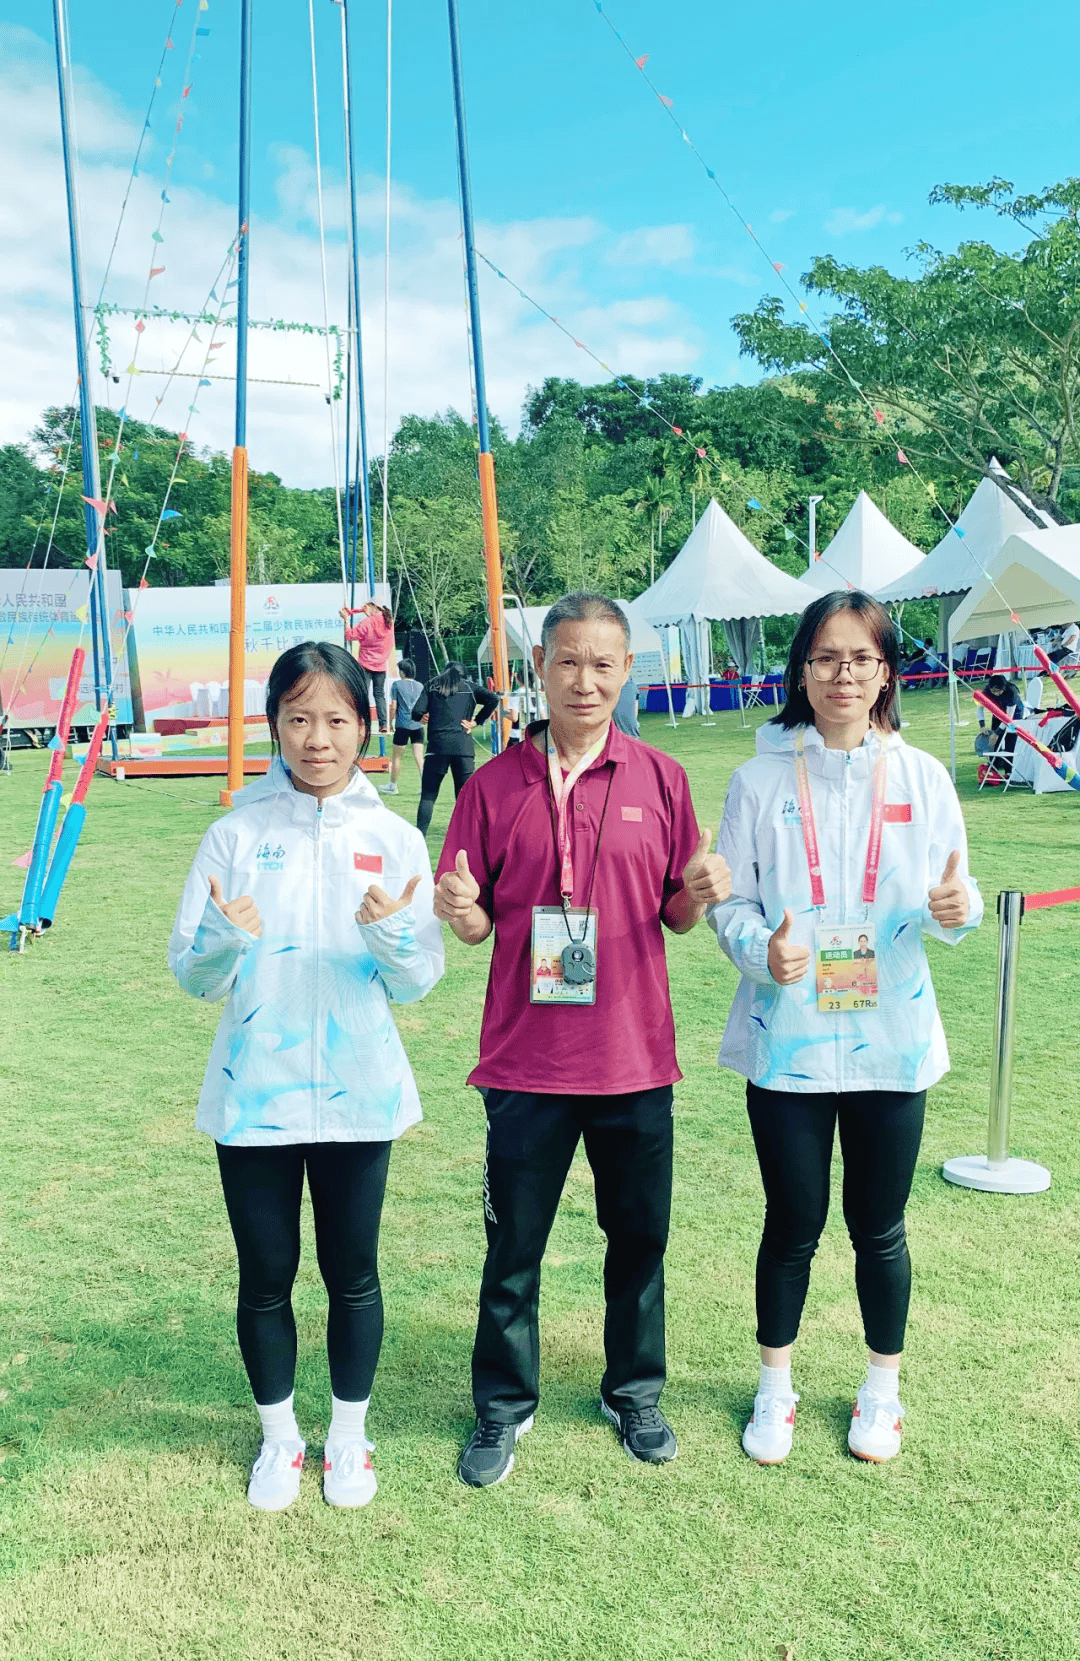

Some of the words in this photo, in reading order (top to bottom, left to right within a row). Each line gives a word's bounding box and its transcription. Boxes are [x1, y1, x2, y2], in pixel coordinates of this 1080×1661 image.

[0, 592, 67, 608] 人民共和国
[256, 842, 286, 859] 海南
[825, 950, 848, 960] 运动员
[828, 1001, 841, 1010] 23
